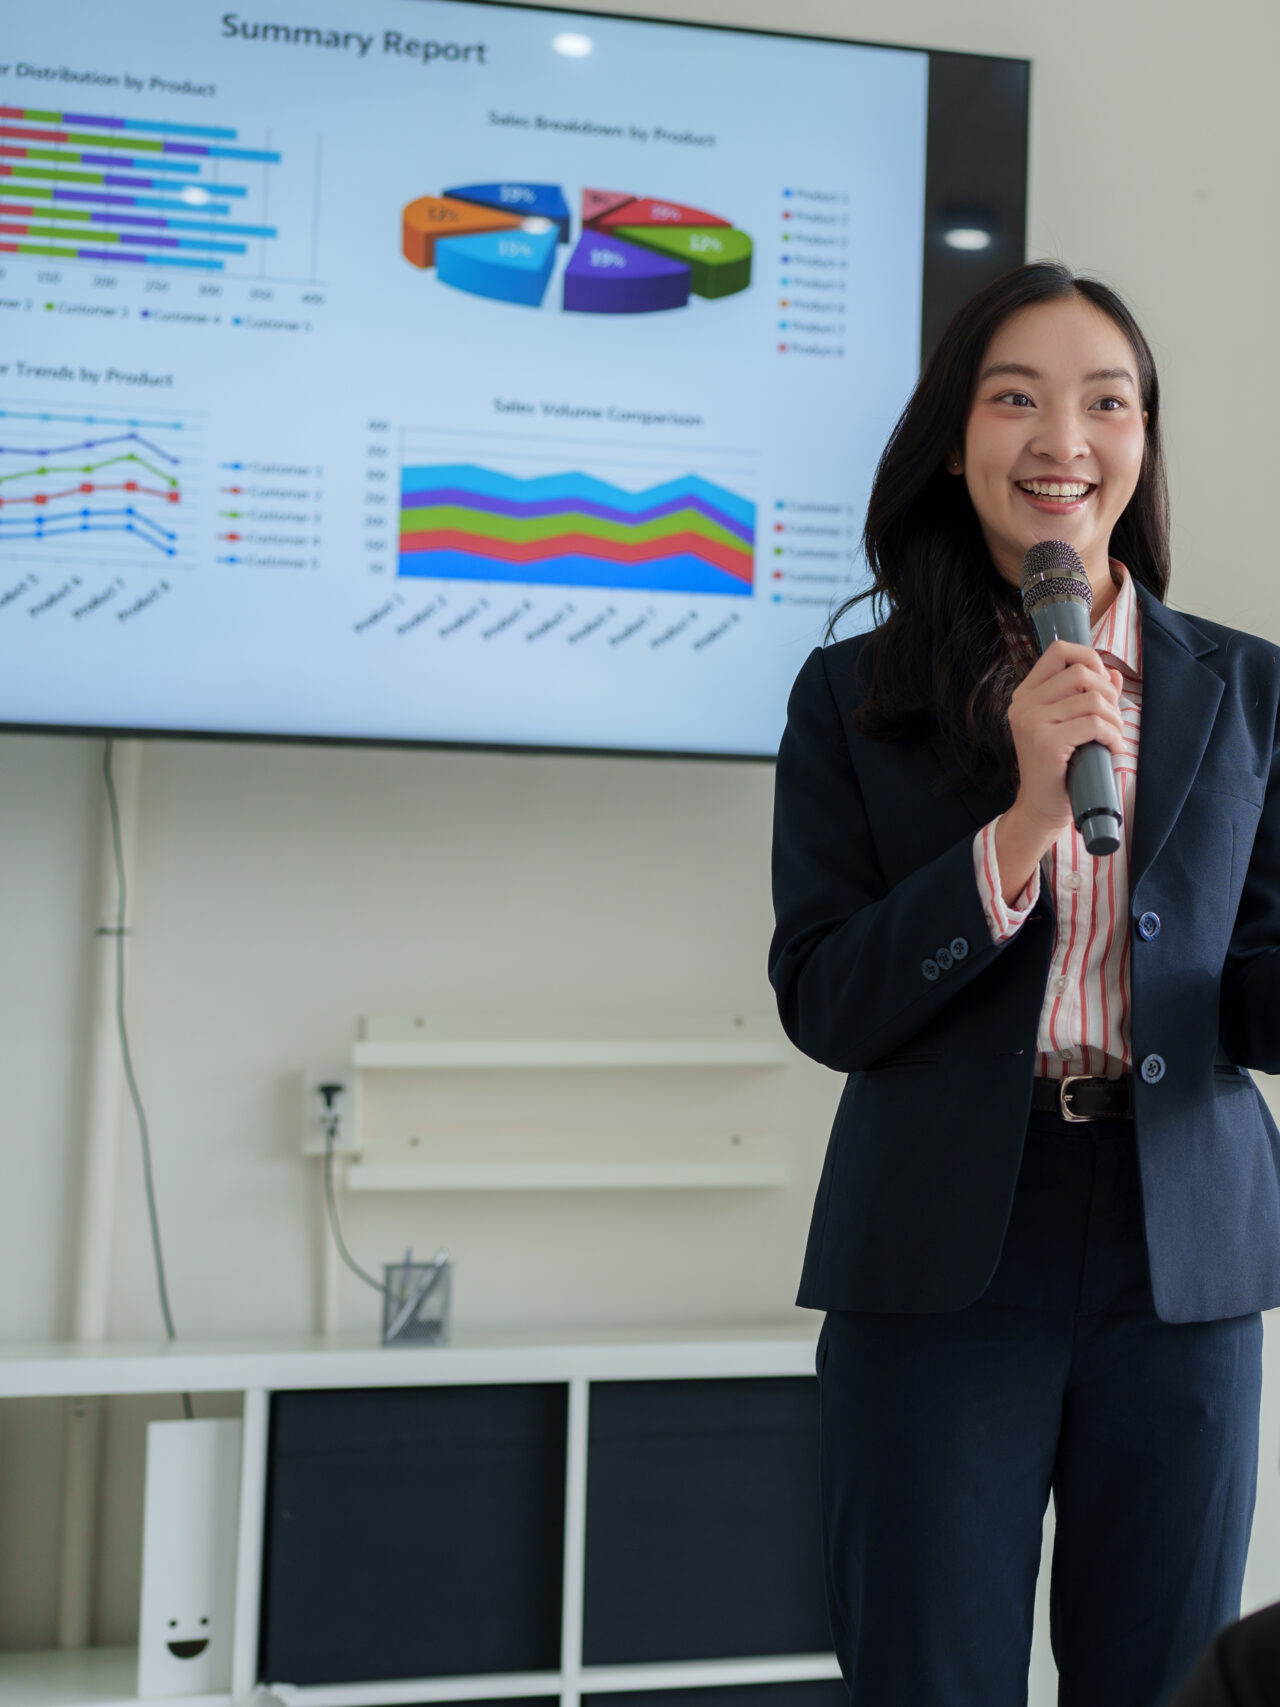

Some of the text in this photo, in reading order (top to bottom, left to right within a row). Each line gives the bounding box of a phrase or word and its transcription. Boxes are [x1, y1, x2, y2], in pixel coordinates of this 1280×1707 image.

[220, 13, 488, 65] Summary Report
[16, 63, 118, 88] Distribution
[124, 73, 145, 94] by
[149, 76, 217, 98] Product
[487, 108, 717, 147] Sales Breakdown by Product
[690, 233, 725, 254] 12%
[590, 248, 628, 269] 19%
[57, 300, 117, 317] Customer
[153, 309, 210, 325] Customer
[244, 316, 300, 332] Customer
[15, 360, 74, 385] Trends
[79, 364, 100, 387] by
[105, 367, 174, 389] Product
[493, 396, 704, 429] Sales Volume Comparison
[248, 461, 310, 477] Customer
[248, 484, 310, 501] Customer
[247, 507, 309, 524] Customer
[247, 531, 308, 548] Customer
[246, 554, 307, 571] Customer
